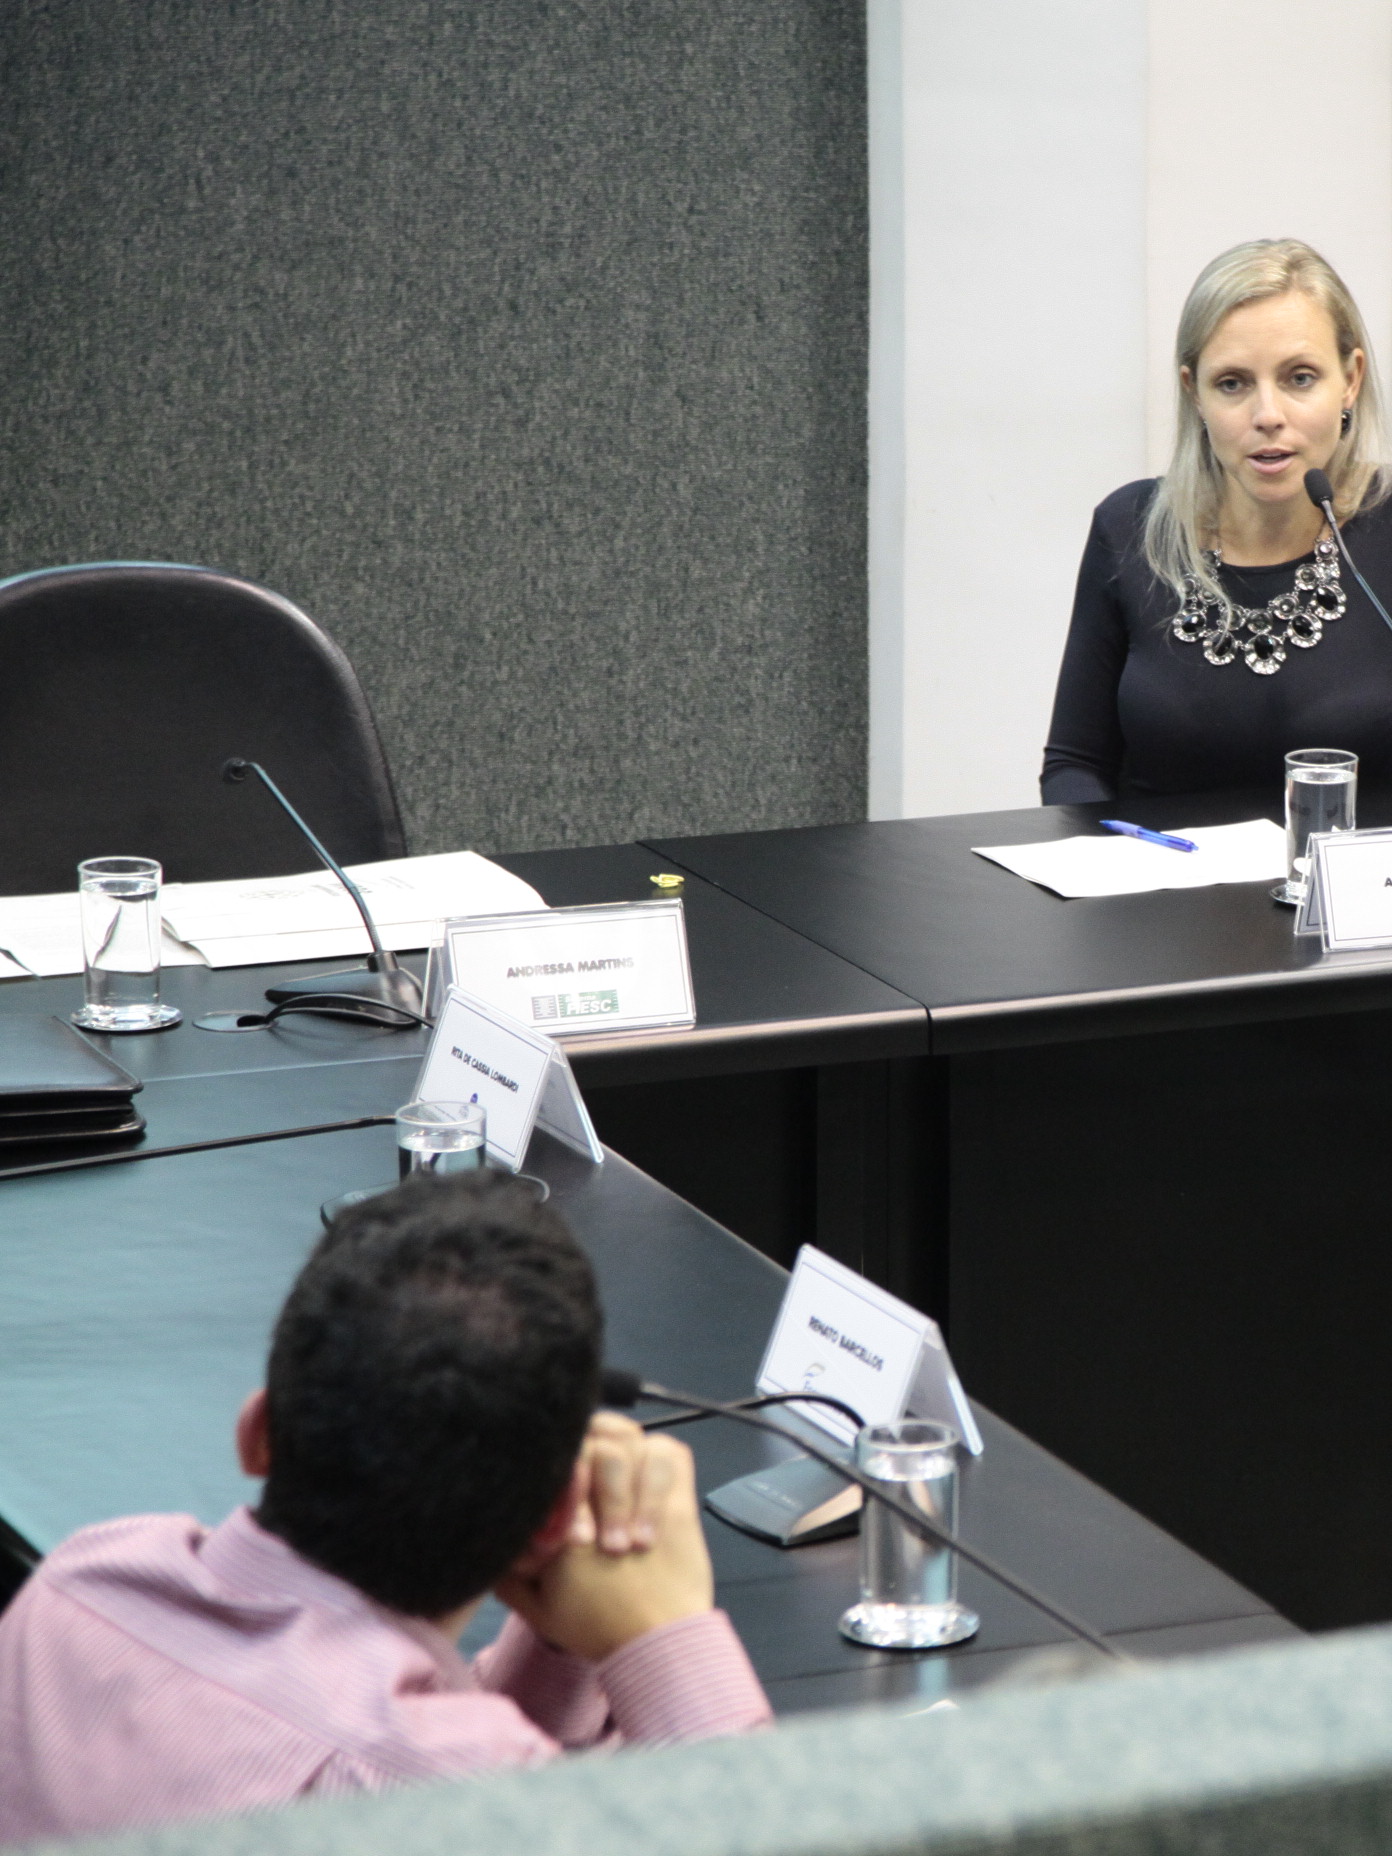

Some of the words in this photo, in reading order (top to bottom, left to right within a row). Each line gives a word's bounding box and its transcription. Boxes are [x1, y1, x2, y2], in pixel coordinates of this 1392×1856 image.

[507, 962, 575, 978] ANDRESSA
[578, 957, 634, 972] MARTINS
[451, 1045, 463, 1060] RITA
[463, 1053, 472, 1065] DE
[471, 1058, 490, 1077] CASSIA
[490, 1069, 519, 1094] LOMBARDI
[808, 1315, 839, 1344] RENATO
[839, 1334, 883, 1373] BARCELLOS
